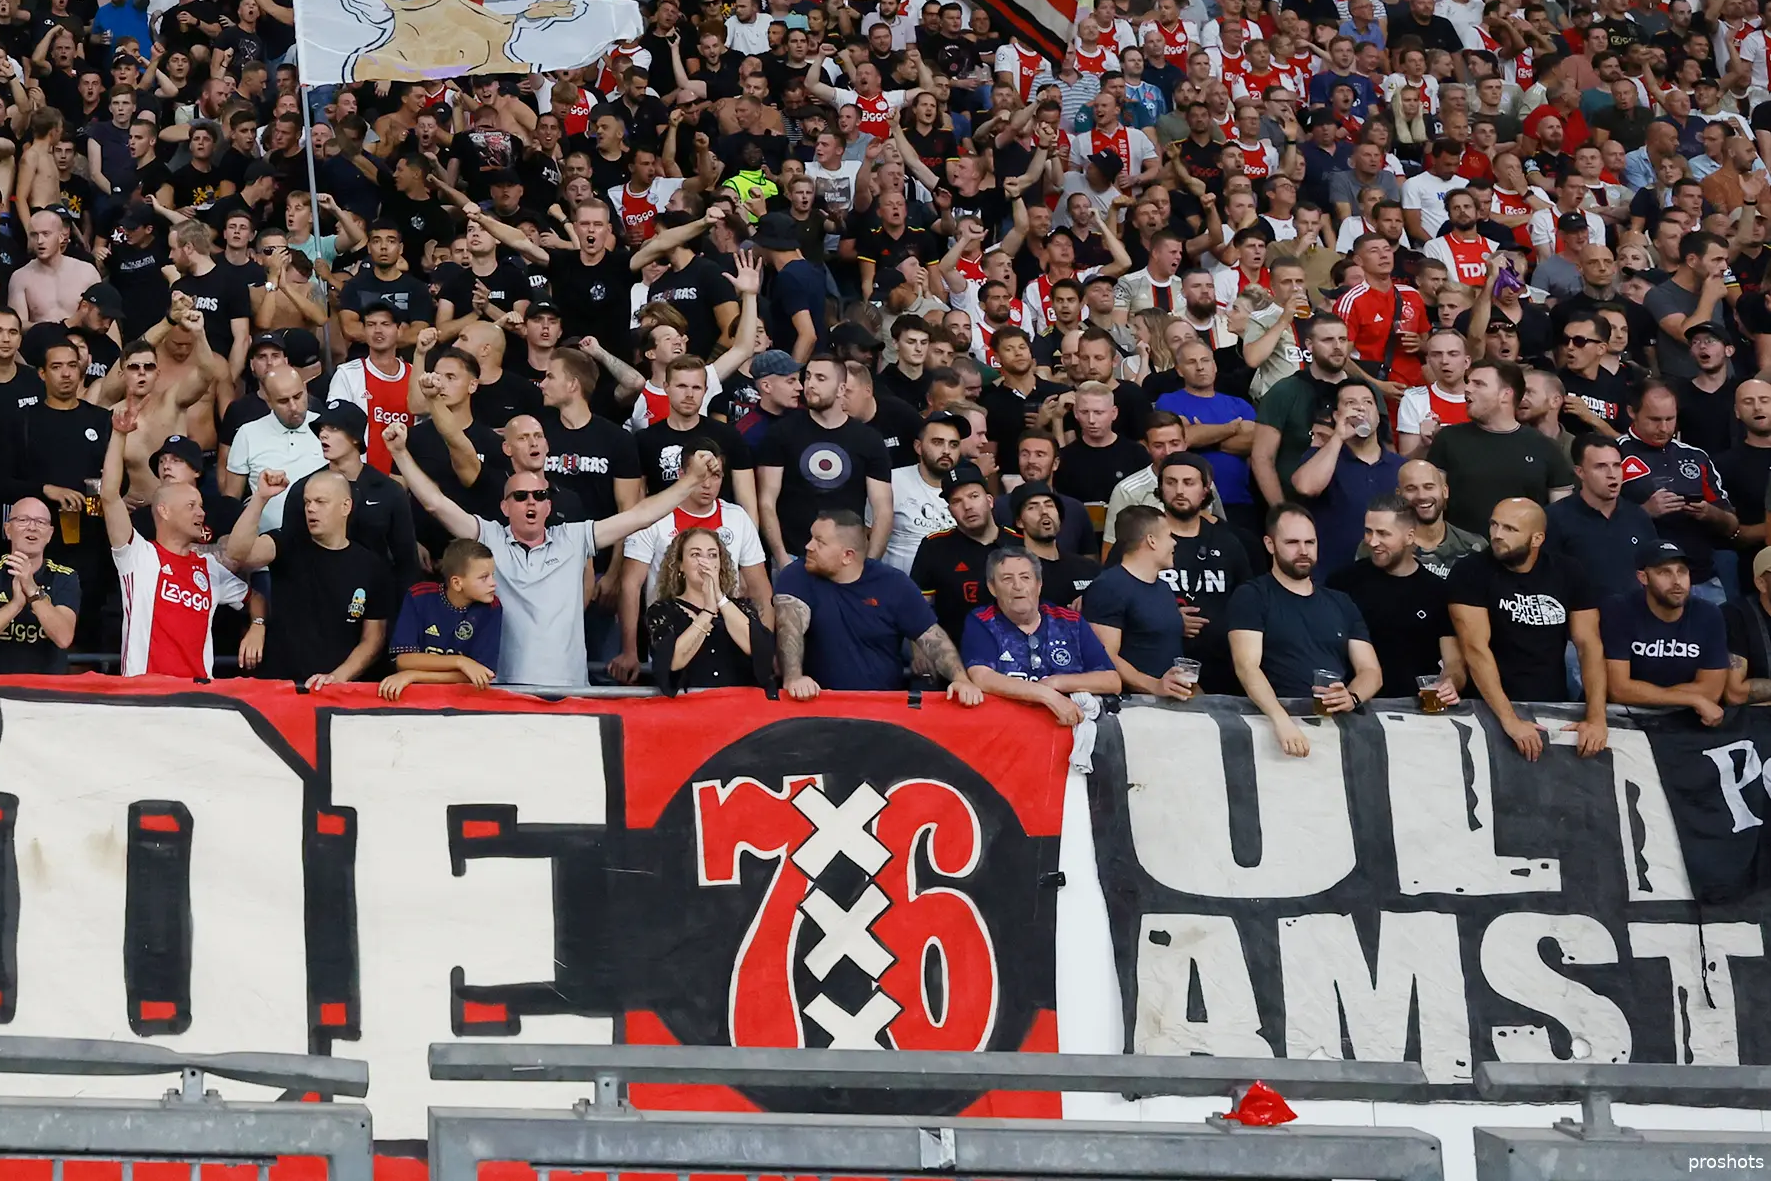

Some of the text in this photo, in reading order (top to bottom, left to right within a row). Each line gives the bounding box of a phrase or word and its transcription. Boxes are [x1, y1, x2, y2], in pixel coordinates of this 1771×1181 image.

[626, 210, 654, 226] Ziggo
[1286, 346, 1313, 362] Zig
[374, 407, 409, 425] Ziggo
[580, 456, 609, 475] RAS
[1159, 569, 1226, 593] RUN
[160, 579, 211, 612] Ziggo
[1514, 593, 1538, 606] THE
[1499, 599, 1540, 616] NORTH
[1512, 612, 1544, 626] FACE
[1631, 638, 1700, 658] adidas
[1702, 739, 1771, 834] P
